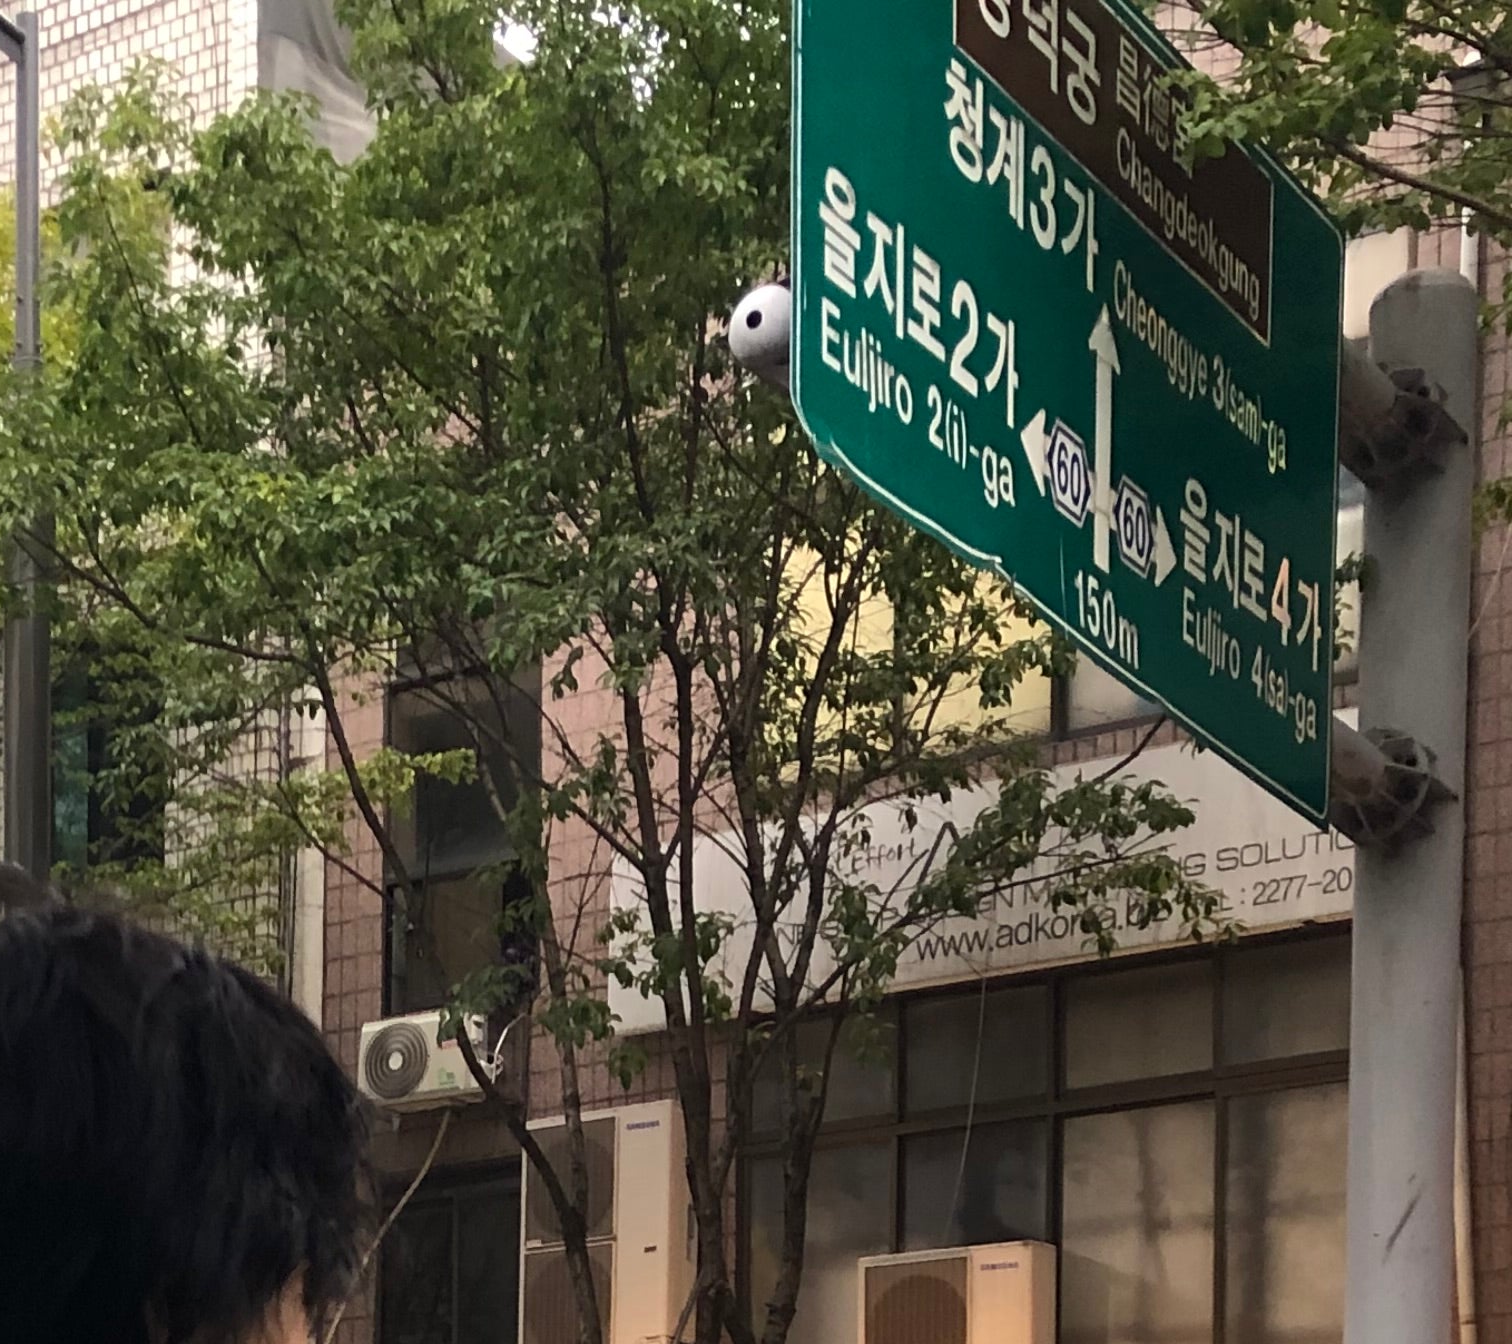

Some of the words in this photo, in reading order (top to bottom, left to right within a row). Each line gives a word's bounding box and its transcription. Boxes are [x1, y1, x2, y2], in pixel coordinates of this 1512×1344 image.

[979, 0, 1101, 126] 덕궁
[944, 57, 1100, 293] 청계3가
[1116, 127, 1261, 322] Changdeokgung
[819, 166, 1019, 429] 을지로2가
[1114, 259, 1208, 400] Cheonggye
[1212, 354, 1287, 475] 3(sam)-ga
[821, 296, 914, 425] Euljiro
[928, 384, 1016, 508] 2(i)-ga
[1056, 441, 1081, 507] 60
[1075, 569, 1140, 670] 150m
[1123, 496, 1147, 559] 60
[1179, 477, 1322, 672] 을지로4가
[1182, 586, 1241, 680] Euljiro
[1251, 645, 1318, 744] 4(sa)-ga
